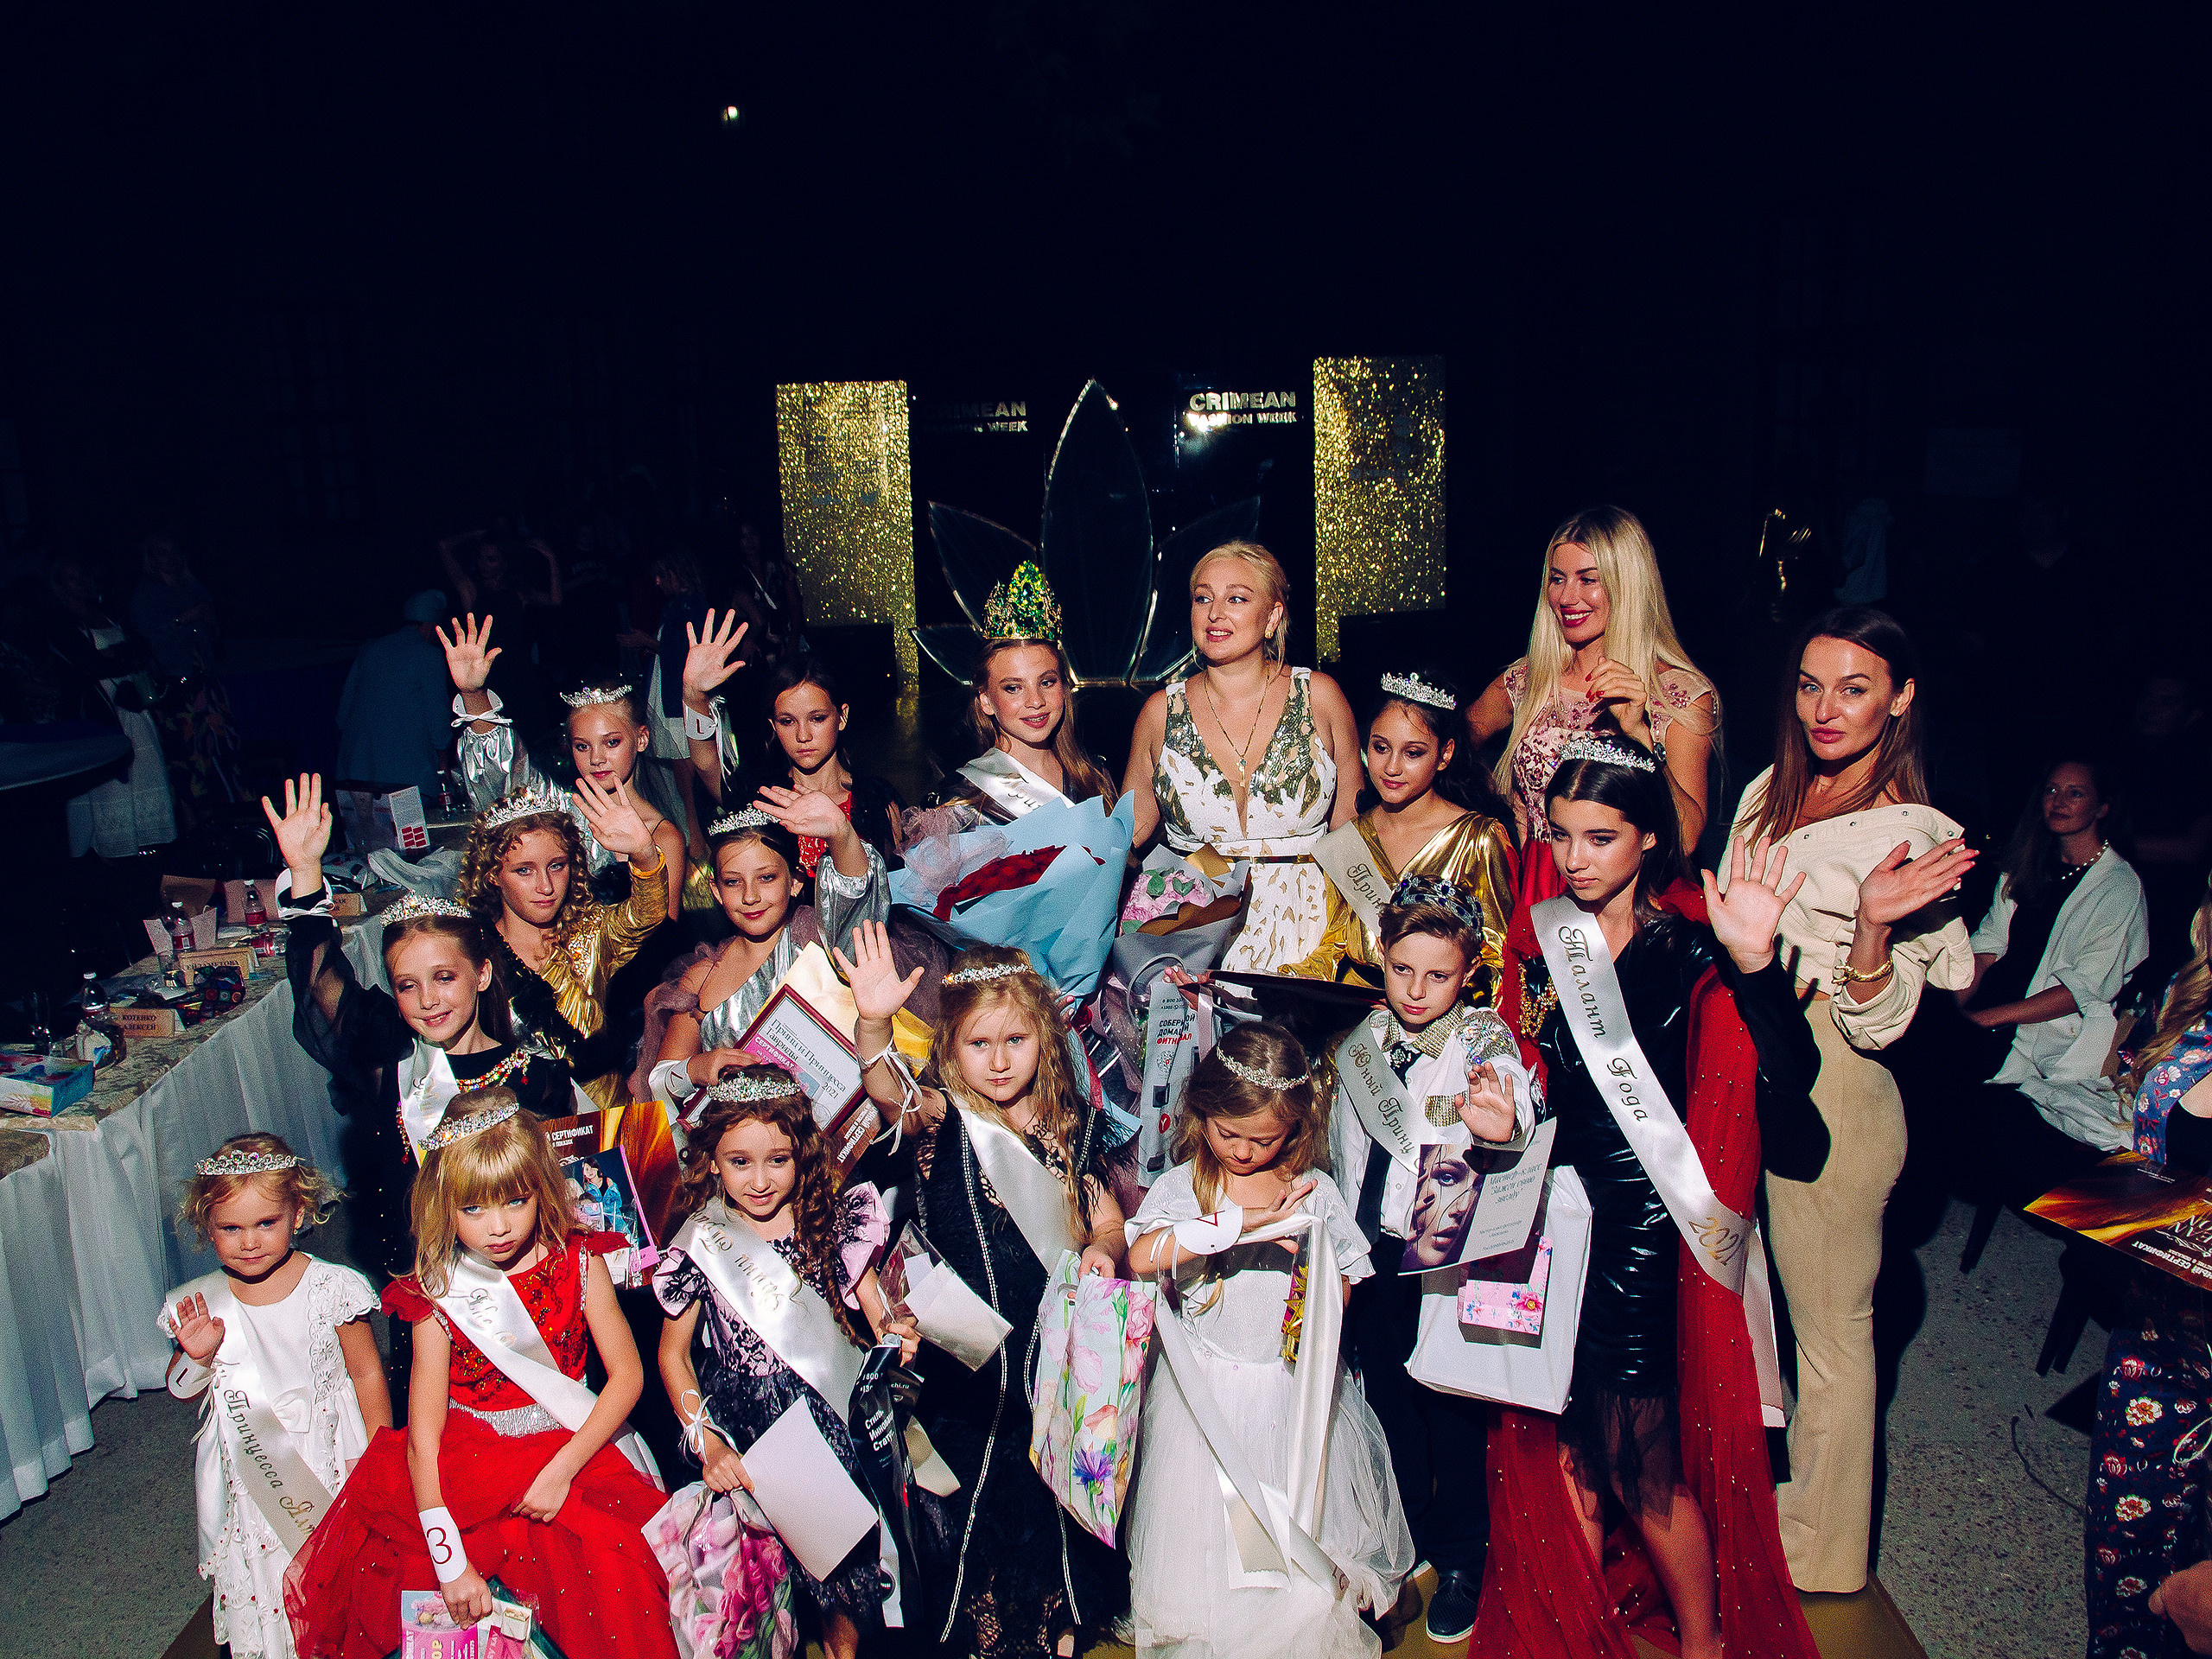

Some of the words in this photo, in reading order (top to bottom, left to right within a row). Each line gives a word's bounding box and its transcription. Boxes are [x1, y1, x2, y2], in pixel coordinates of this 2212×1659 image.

[1189, 391, 1296, 411] CRIMEAN
[987, 420, 1028, 432] WEEK
[1346, 862, 1386, 914] Прин
[771, 1019, 799, 1049] Принц
[1557, 925, 1607, 1039] Талант
[1605, 1056, 1649, 1122] Года
[753, 1036, 795, 1069] СЕРТИФИКАТ
[821, 1082, 839, 1100] 2021
[1348, 1042, 1383, 1096] Юный
[1377, 1096, 1415, 1154] Принц
[551, 1124, 594, 1141] СЕРТИФИКАТ
[836, 1125, 866, 1163] СЕРТИФИКАТ
[1688, 1216, 1746, 1267] 2021
[2131, 1241, 2192, 1269] СЕРТИФИКАТ
[865, 1408, 885, 1430] Стиль
[223, 1389, 284, 1490] Принцесса
[426, 1527, 453, 1565] 3
